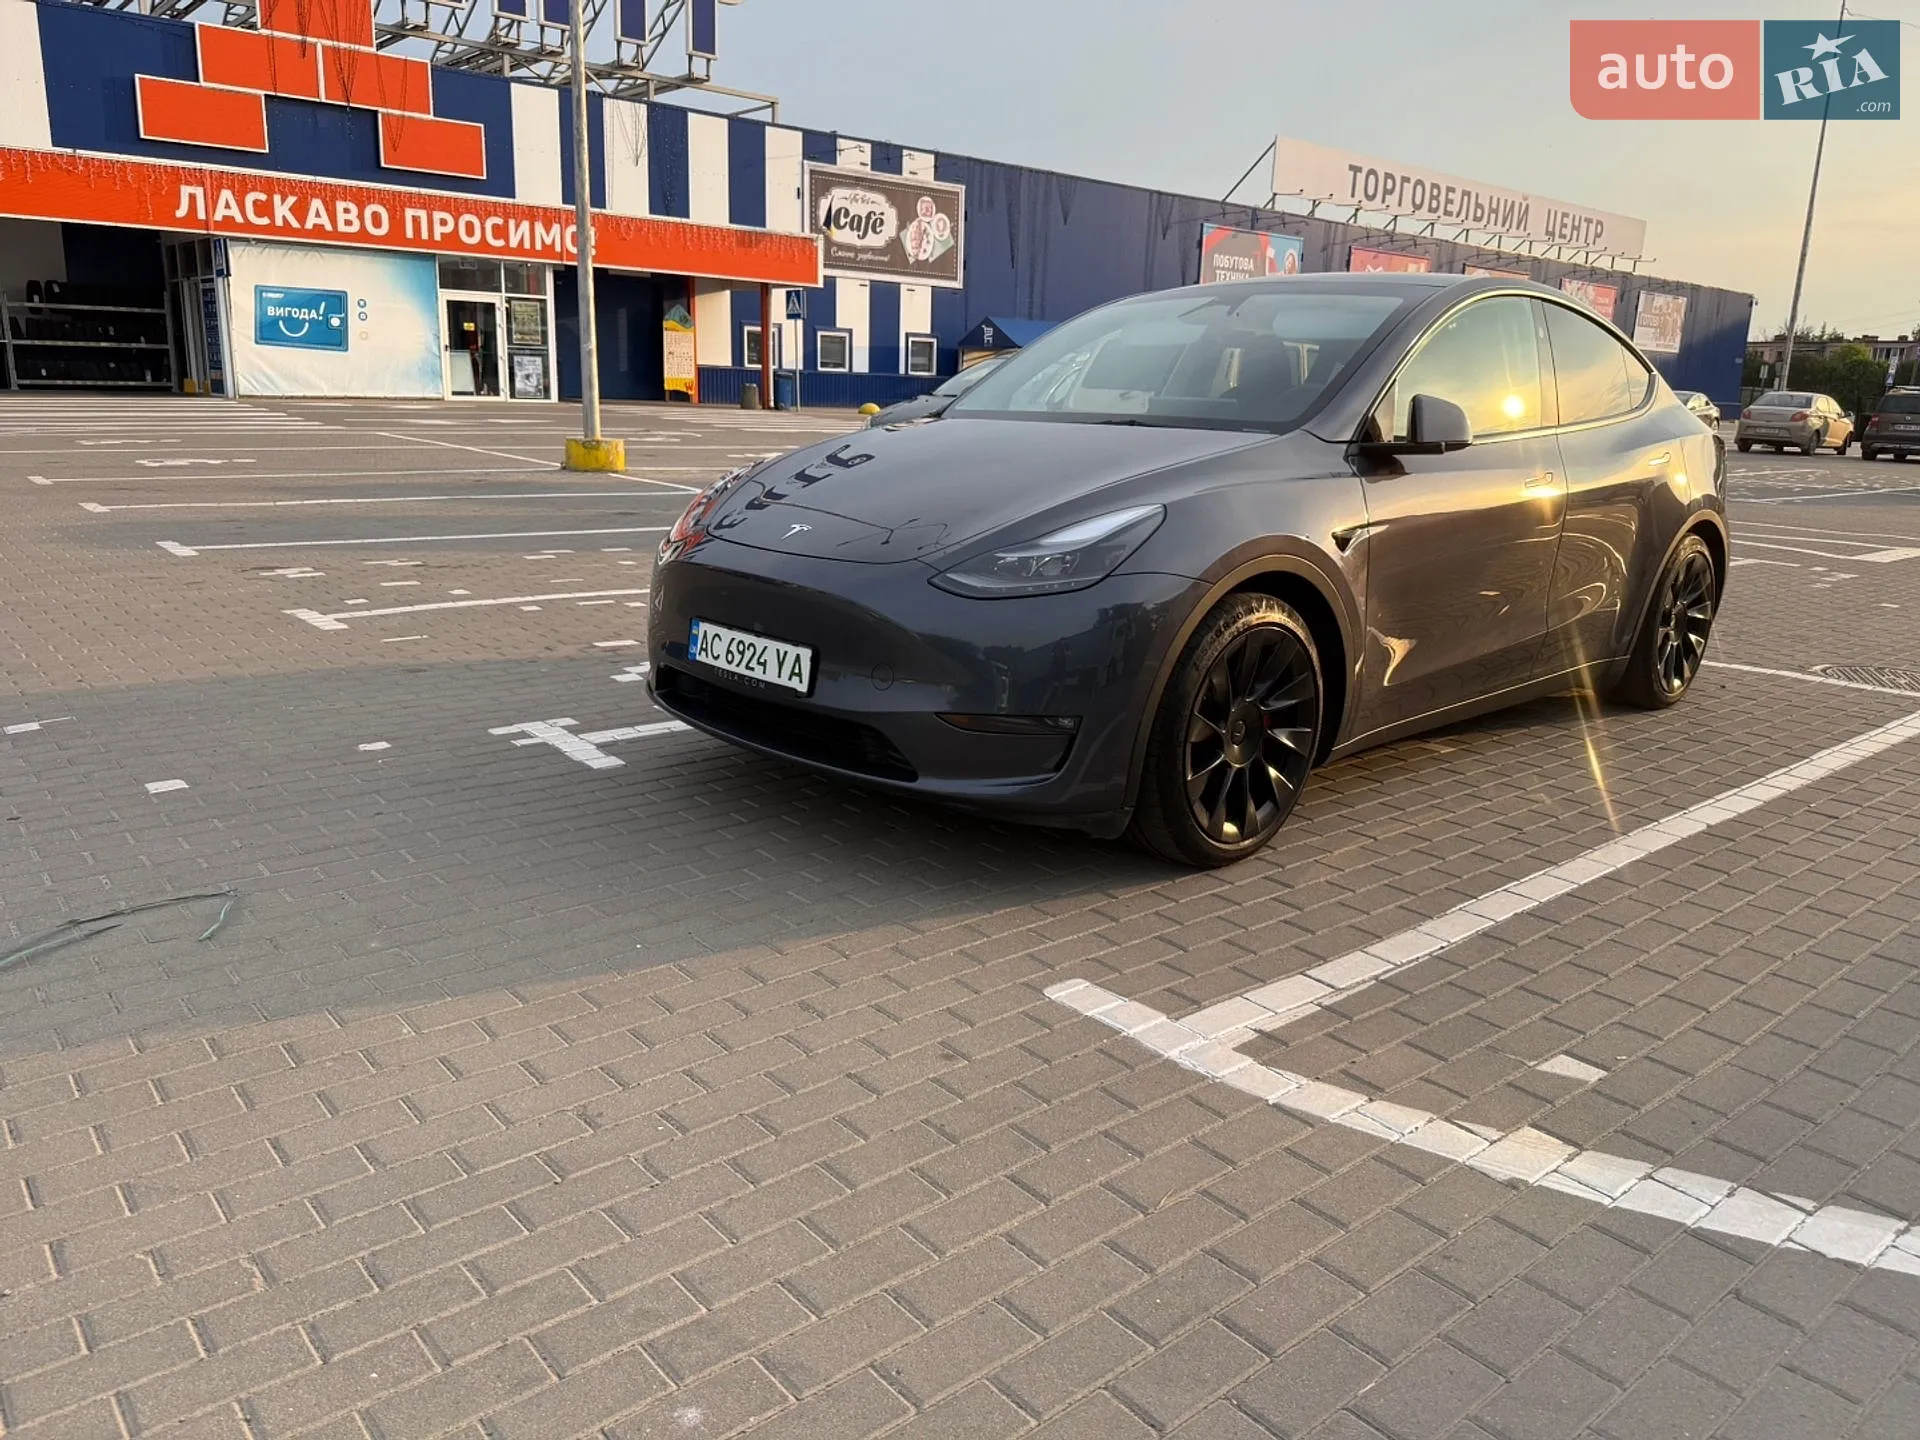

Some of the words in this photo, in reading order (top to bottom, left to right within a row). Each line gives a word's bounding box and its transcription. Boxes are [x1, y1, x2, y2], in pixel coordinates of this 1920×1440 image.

[174, 184, 391, 237] ЛАСКАВО
[833, 206, 885, 240] Café
[1348, 163, 1530, 233] ТОРГОВЕЛЬНИЙ
[1545, 207, 1605, 246] ЦЕНТР
[1213, 253, 1255, 272] ПОБУТОВА
[267, 301, 326, 321] ВИГОДА!
[698, 629, 722, 661] AC
[725, 637, 769, 675] 6924
[775, 647, 804, 684] YA
